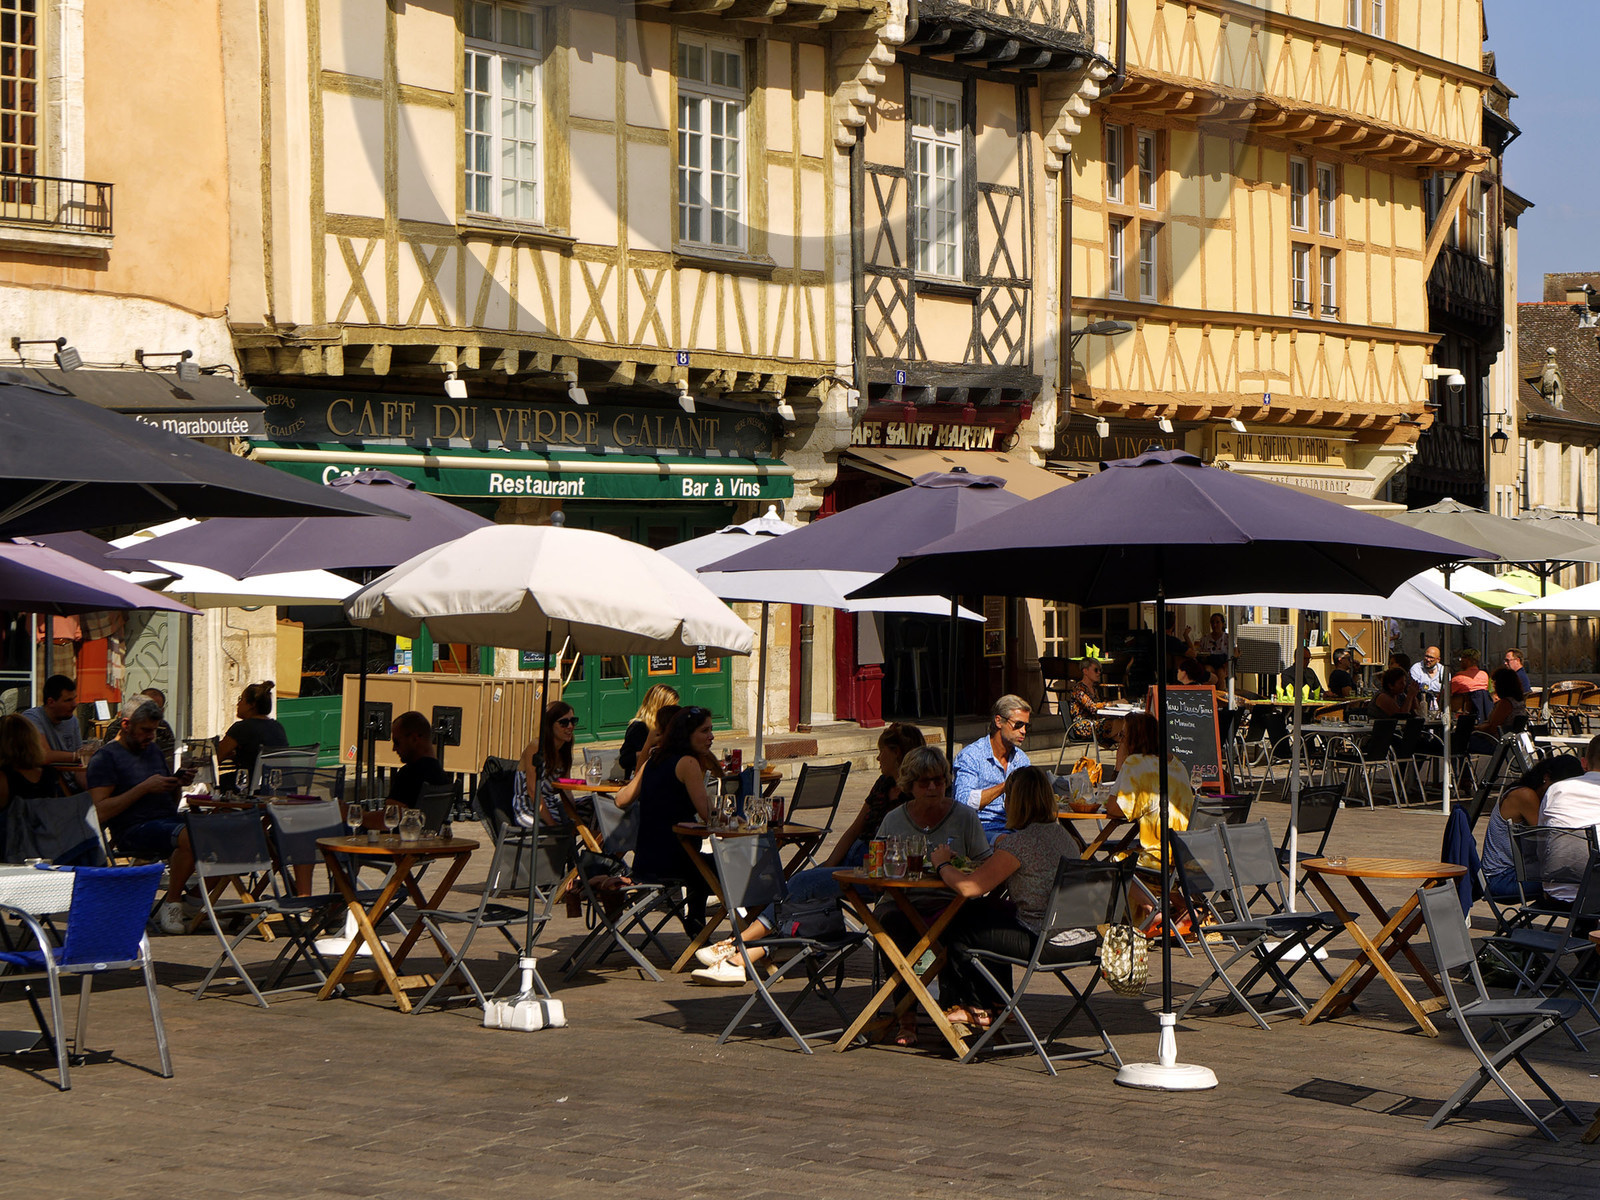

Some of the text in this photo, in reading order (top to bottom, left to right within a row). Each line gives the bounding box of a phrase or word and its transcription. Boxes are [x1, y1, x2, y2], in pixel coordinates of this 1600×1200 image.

[680, 352, 687, 364] 8
[898, 371, 904, 383] 6
[265, 394, 295, 409] REPAS
[162, 416, 249, 435] maraboutée
[326, 398, 720, 450] CAFE DU VERRE GALANT
[850, 421, 996, 450] AFE SAINT MARTIN
[1060, 433, 1105, 458] SAINT
[1236, 434, 1329, 464] AUX SAVEURS D'ANTAN
[489, 473, 586, 496] Restaurant
[682, 477, 761, 497] Bar à Vins
